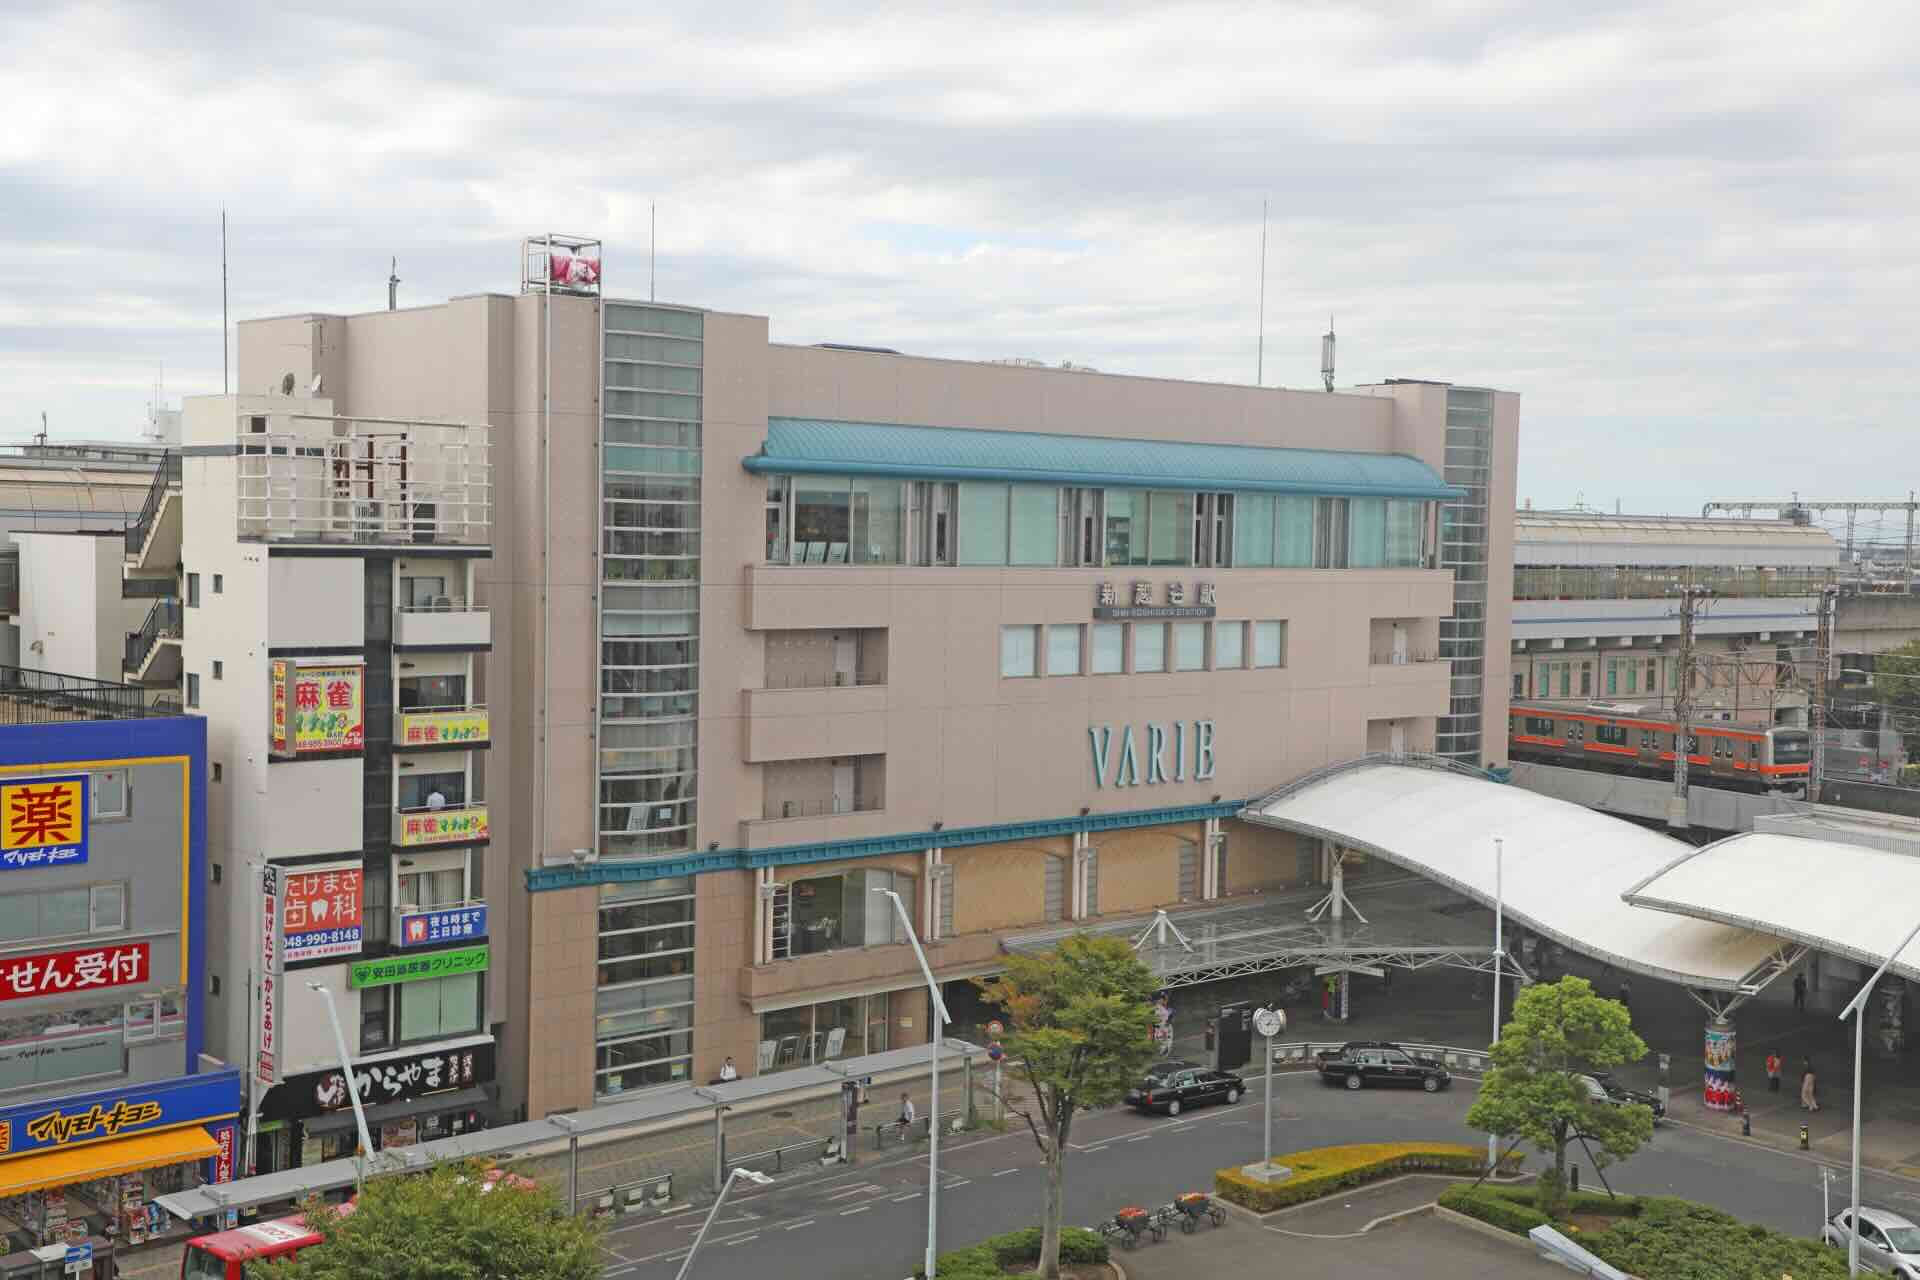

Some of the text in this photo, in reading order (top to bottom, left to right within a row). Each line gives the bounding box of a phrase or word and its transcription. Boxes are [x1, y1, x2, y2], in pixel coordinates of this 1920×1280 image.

[296, 681, 353, 709] 麻雀
[1089, 719, 1216, 788] VARIE
[10, 785, 73, 845] 薬
[284, 871, 360, 897] たけまさ
[0, 948, 142, 994] せん受付
[353, 1057, 445, 1096] からやま
[28, 1101, 162, 1141] マツモトキヨシ
